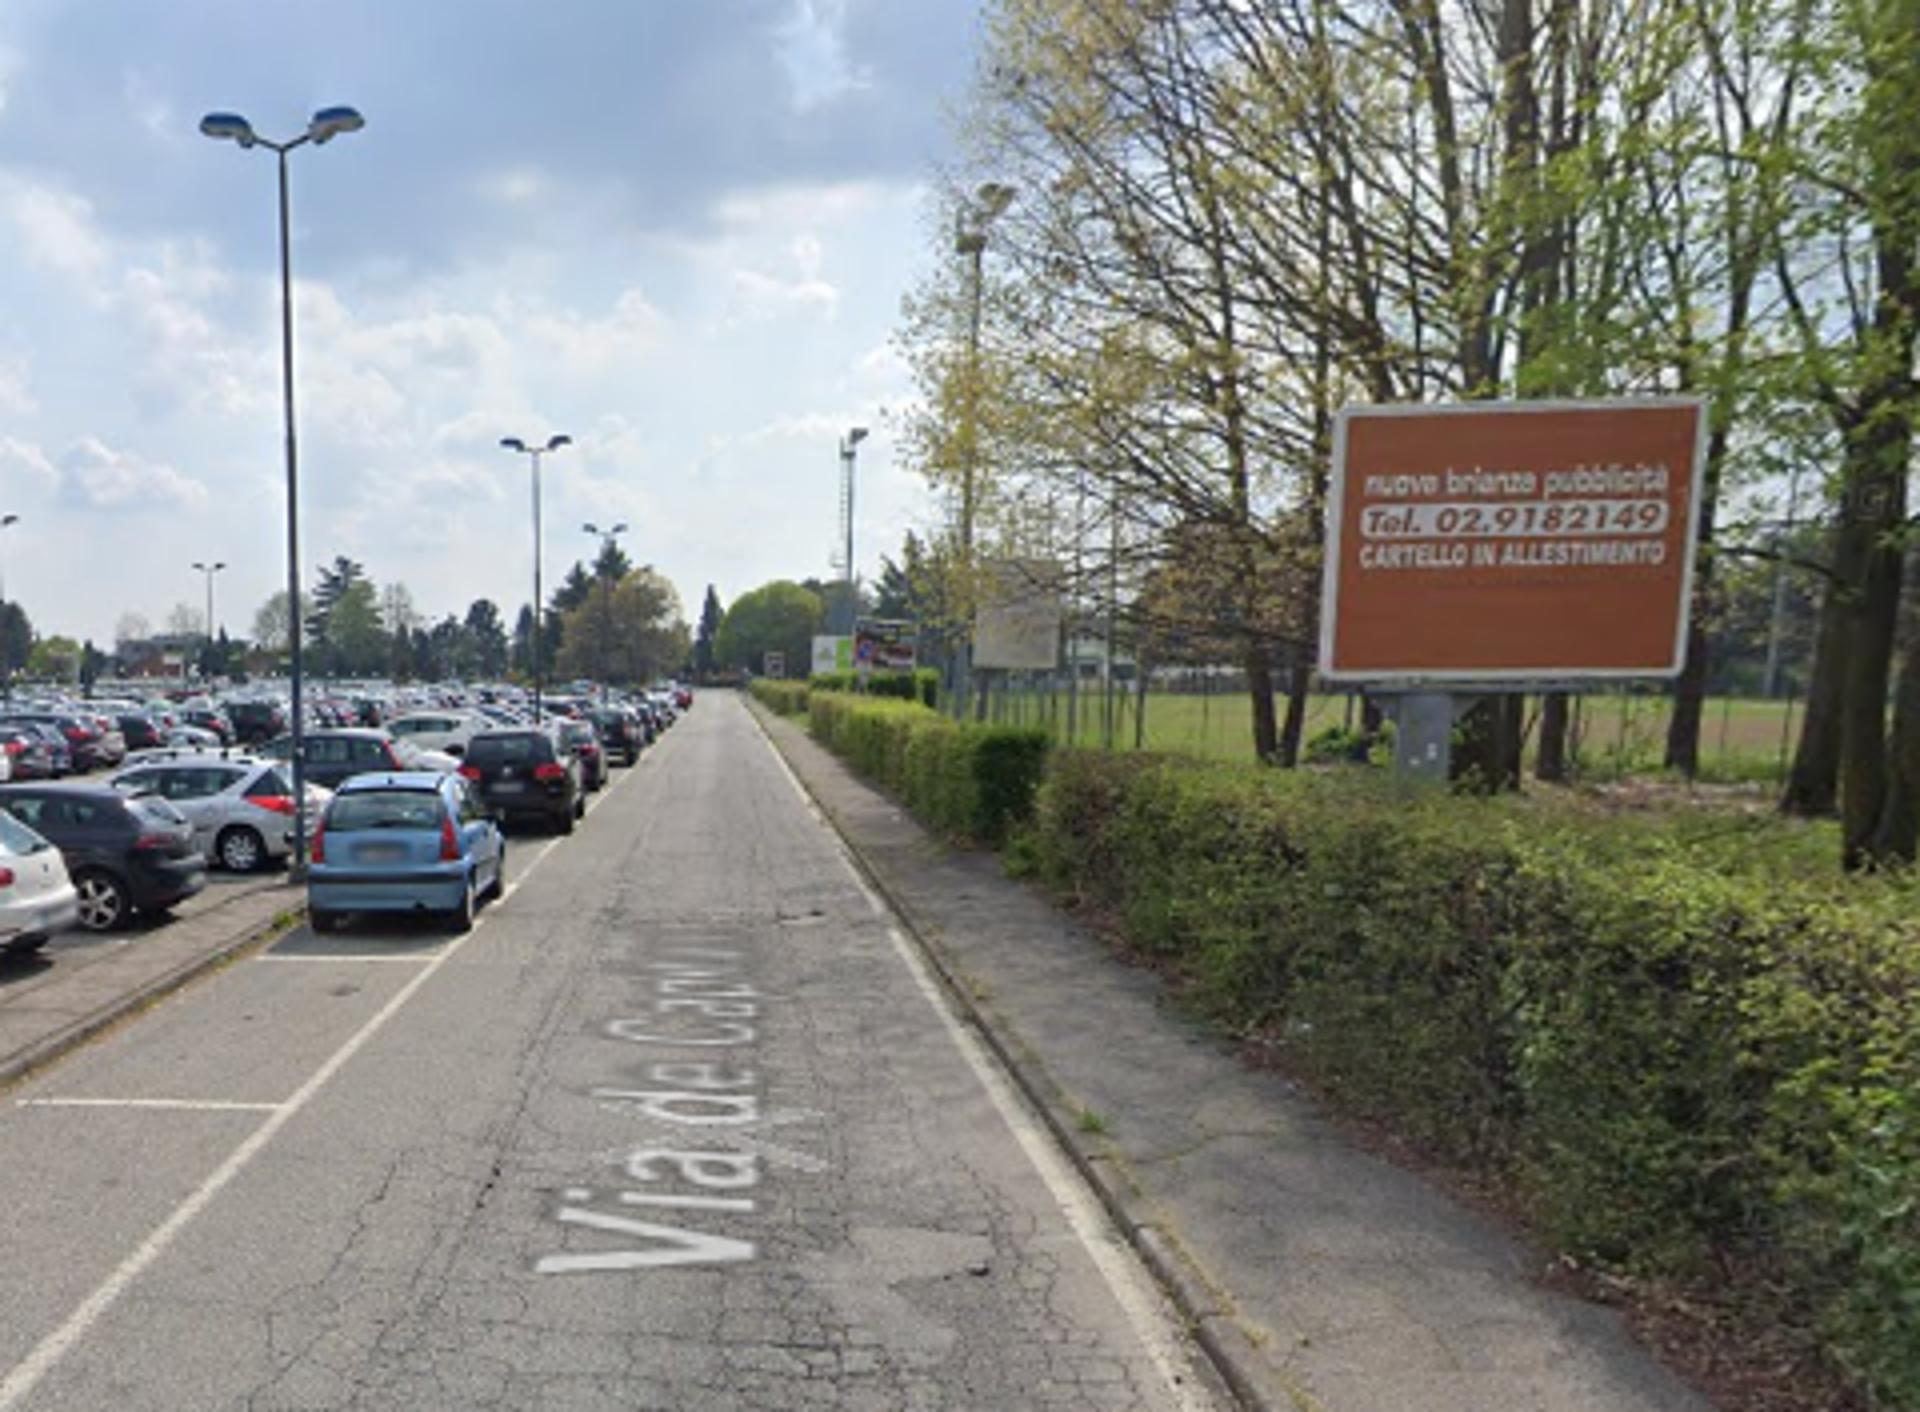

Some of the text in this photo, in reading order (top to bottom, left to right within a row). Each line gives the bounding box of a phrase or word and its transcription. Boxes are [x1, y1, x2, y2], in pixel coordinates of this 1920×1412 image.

[1367, 503, 1662, 533] Tel. 02.9182149
[1359, 540, 1666, 569] CARTELLO IN ALLESTIMENTO
